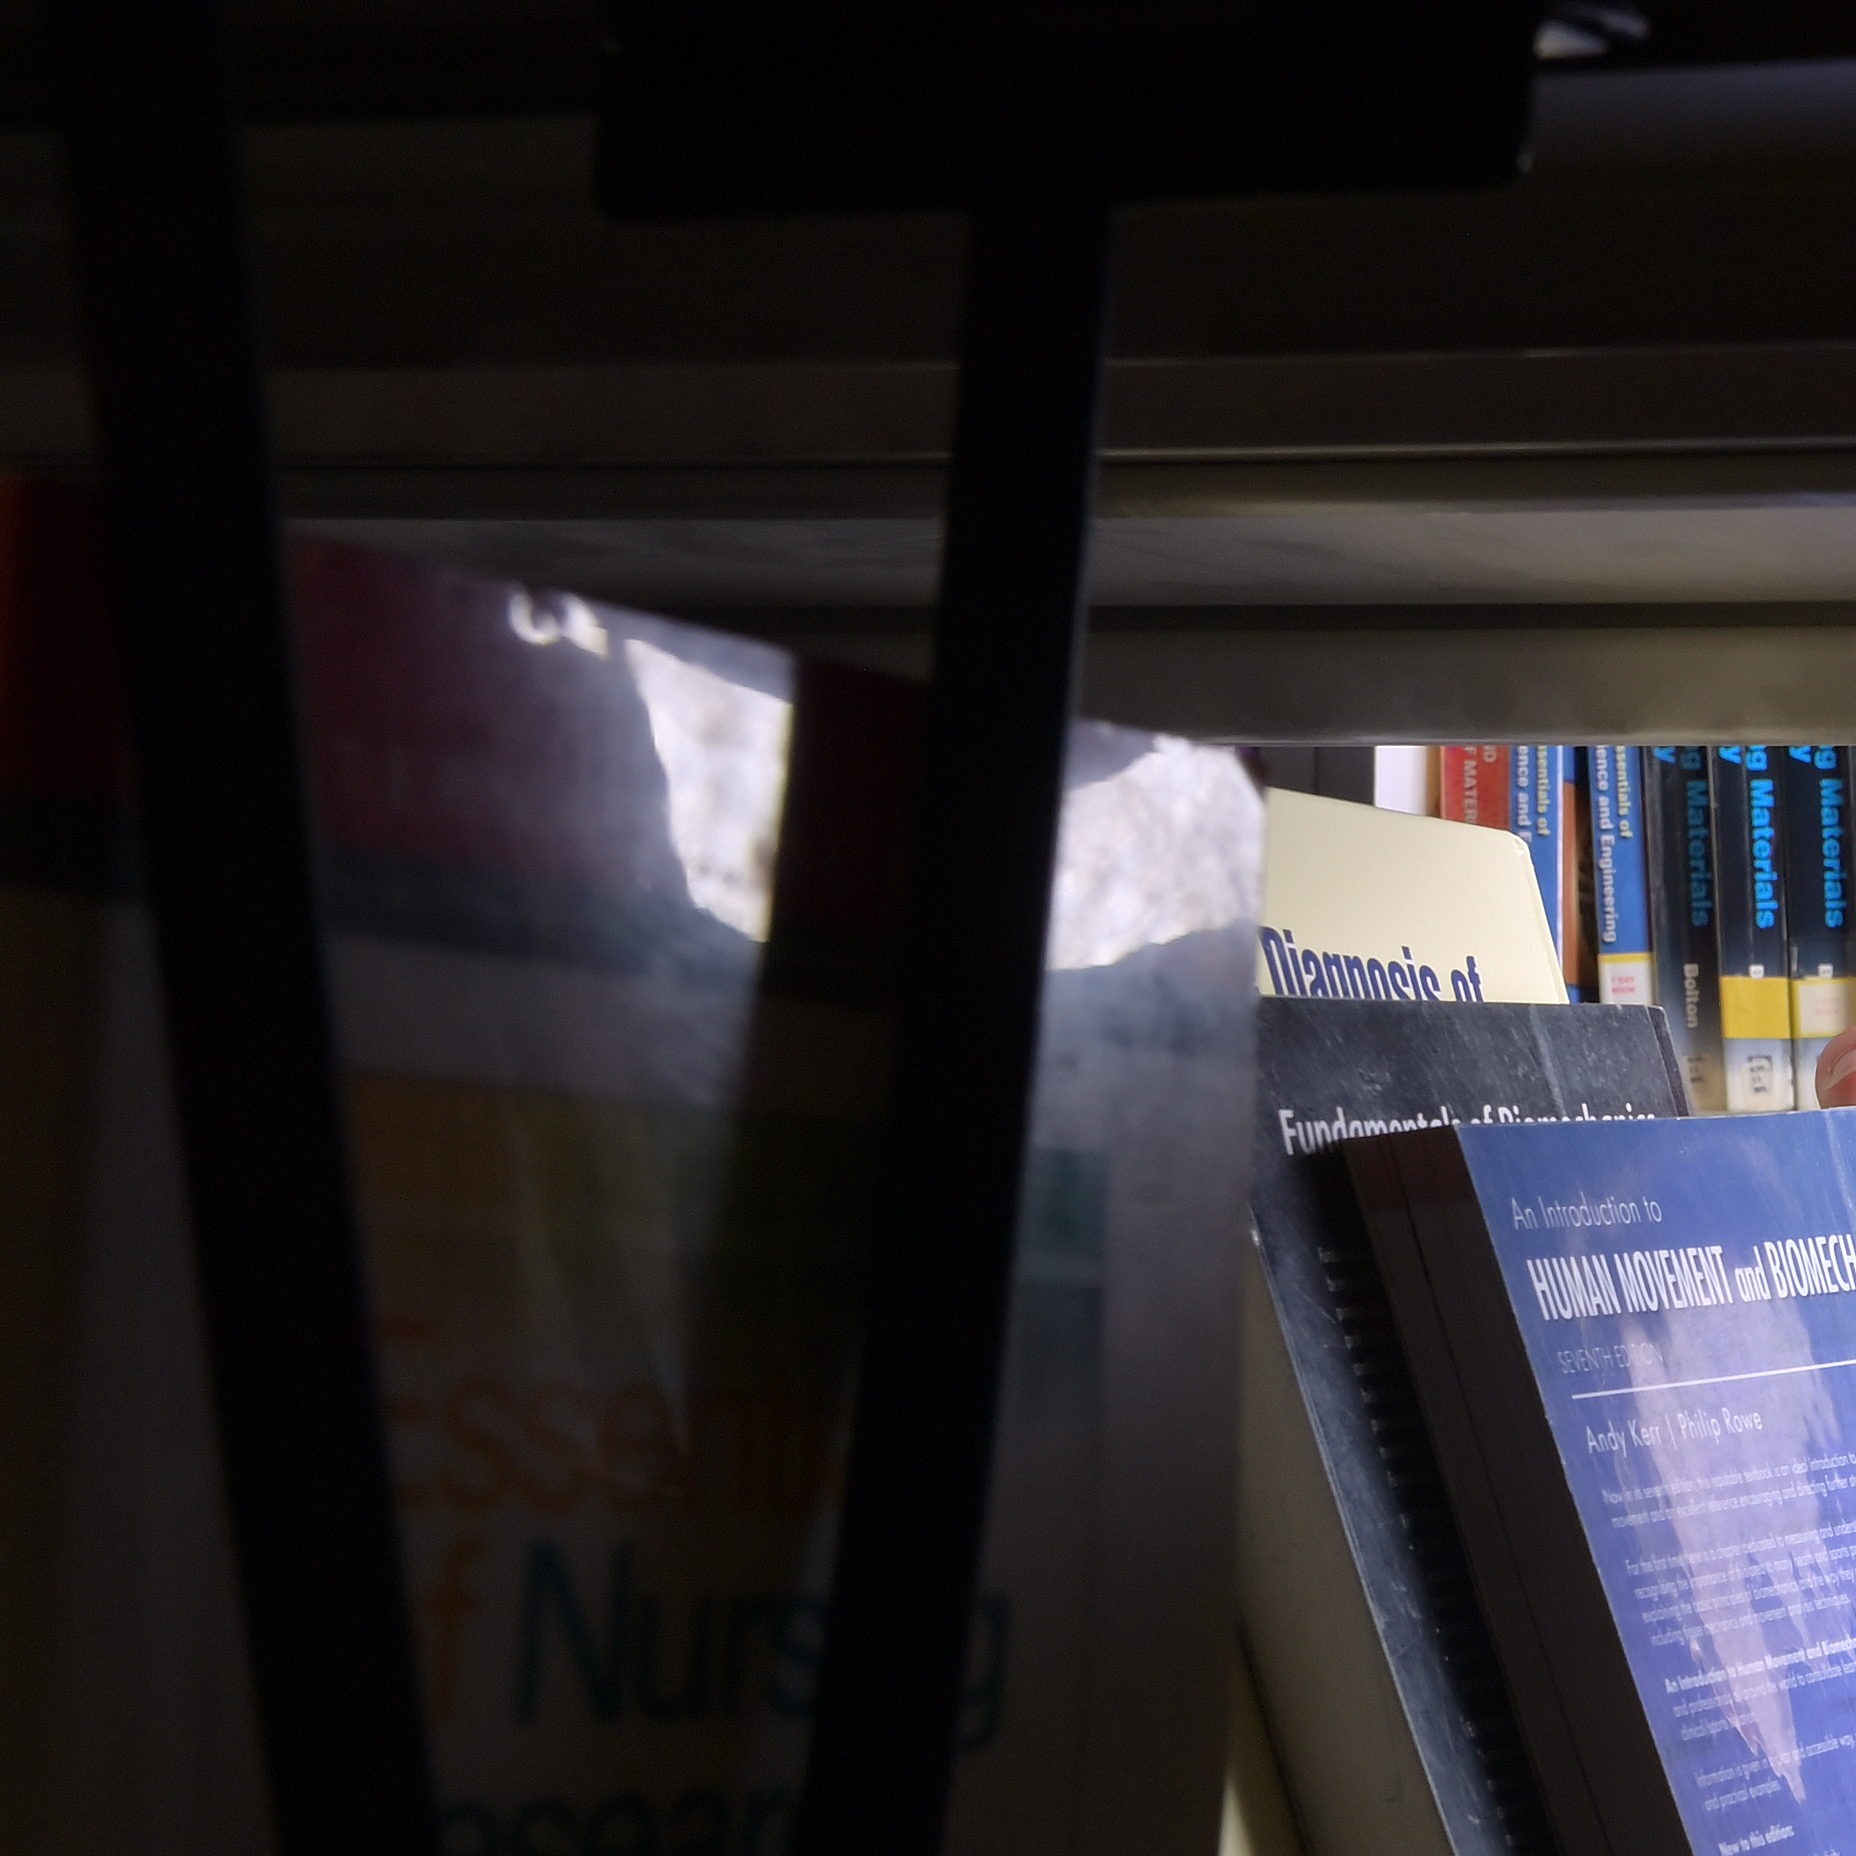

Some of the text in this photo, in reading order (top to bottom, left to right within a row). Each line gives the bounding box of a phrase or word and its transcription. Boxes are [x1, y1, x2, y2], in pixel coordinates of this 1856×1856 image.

[1597, 795, 1619, 943] and Engineering
[1685, 780, 1714, 928] Materials
[1750, 778, 1779, 930] Materials
[1819, 777, 1848, 929] Materials
[1258, 925, 1486, 1002] Diagnosis of
[1684, 963, 1699, 1029] Bolton
[1506, 1189, 1665, 1230] An Introduction to
[1527, 1255, 1620, 1320] HUMAN
[1613, 1246, 1735, 1313] MOVEMENT
[1728, 1247, 1770, 1301] and
[1557, 1346, 1612, 1374] SEVENTH
[1582, 1403, 1763, 1461] Andy Kerr Philip Rowe
[515, 1536, 1014, 1754] Nursg
[1747, 1829, 1765, 1849] this
